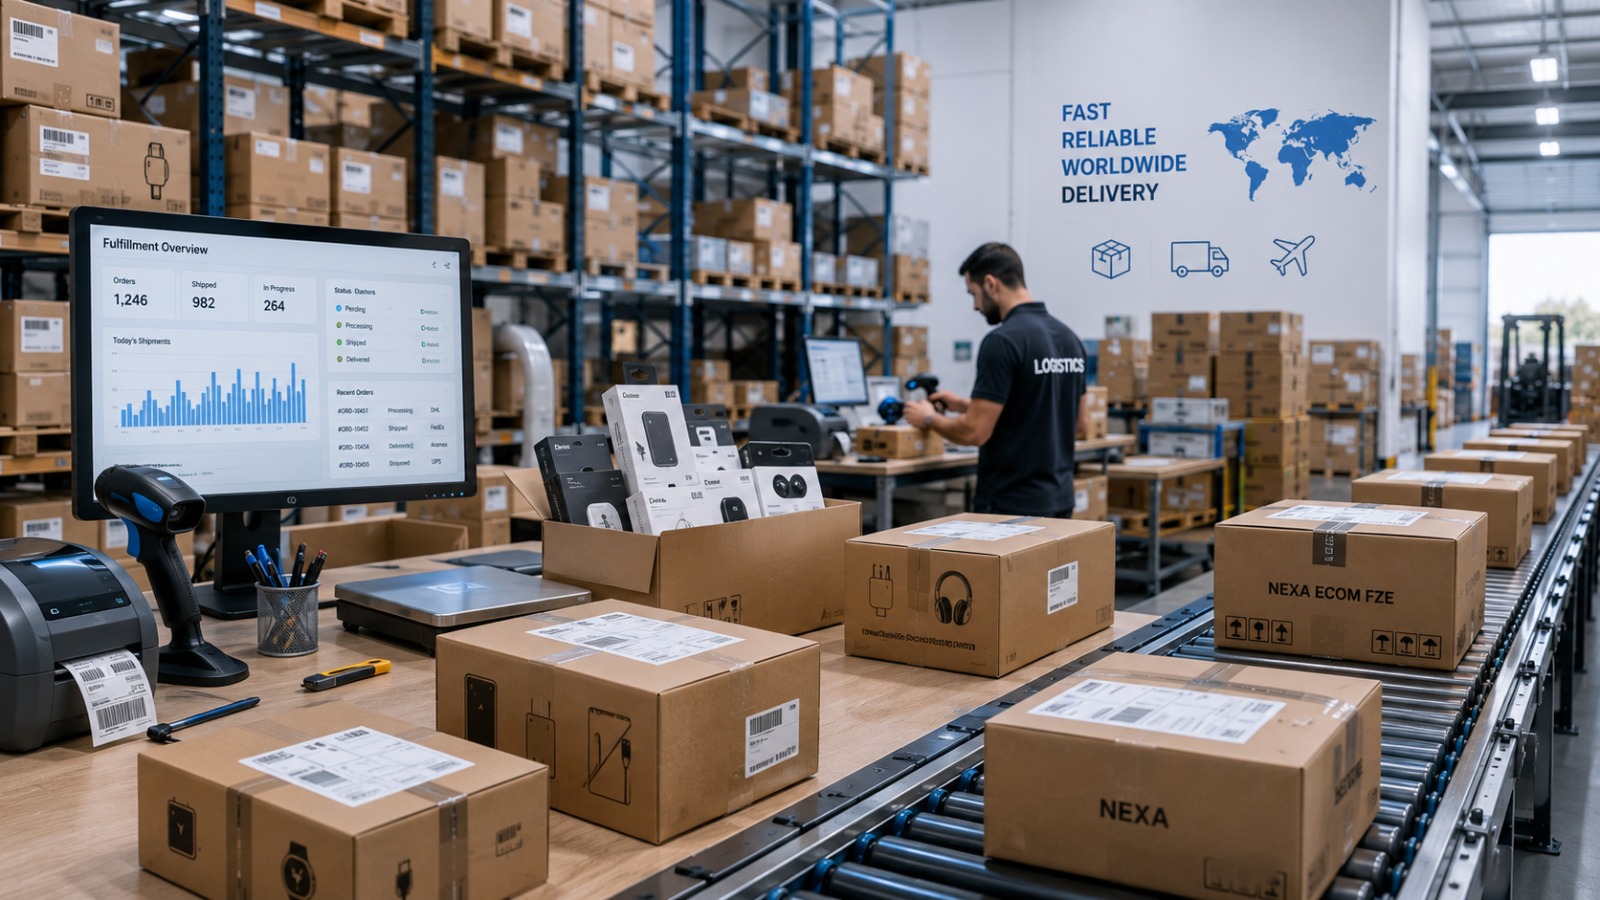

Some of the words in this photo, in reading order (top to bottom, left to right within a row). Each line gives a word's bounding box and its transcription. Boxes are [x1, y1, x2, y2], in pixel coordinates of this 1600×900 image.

[1062, 102, 1111, 122] FAST
[1062, 127, 1156, 149] RELIABLE
[1061, 154, 1187, 176] WORLDWIDE
[1062, 183, 1159, 203] DELIVERY
[103, 237, 159, 251] Fulfillment
[161, 241, 208, 255] Overview
[113, 276, 136, 285] Orders
[191, 280, 217, 289] Shipped
[270, 284, 295, 293] Progress
[113, 293, 148, 307] 1,246
[192, 296, 215, 309] 982
[263, 299, 285, 312] 264
[345, 305, 366, 314] Pending
[113, 336, 137, 345] Today's
[138, 337, 171, 345] Shipments
[1033, 357, 1085, 375] LOGISTICS
[1268, 581, 1311, 598] NEXA
[1315, 585, 1361, 602] ECOM
[1365, 589, 1395, 605] FZE
[1100, 798, 1170, 829] NEXA
